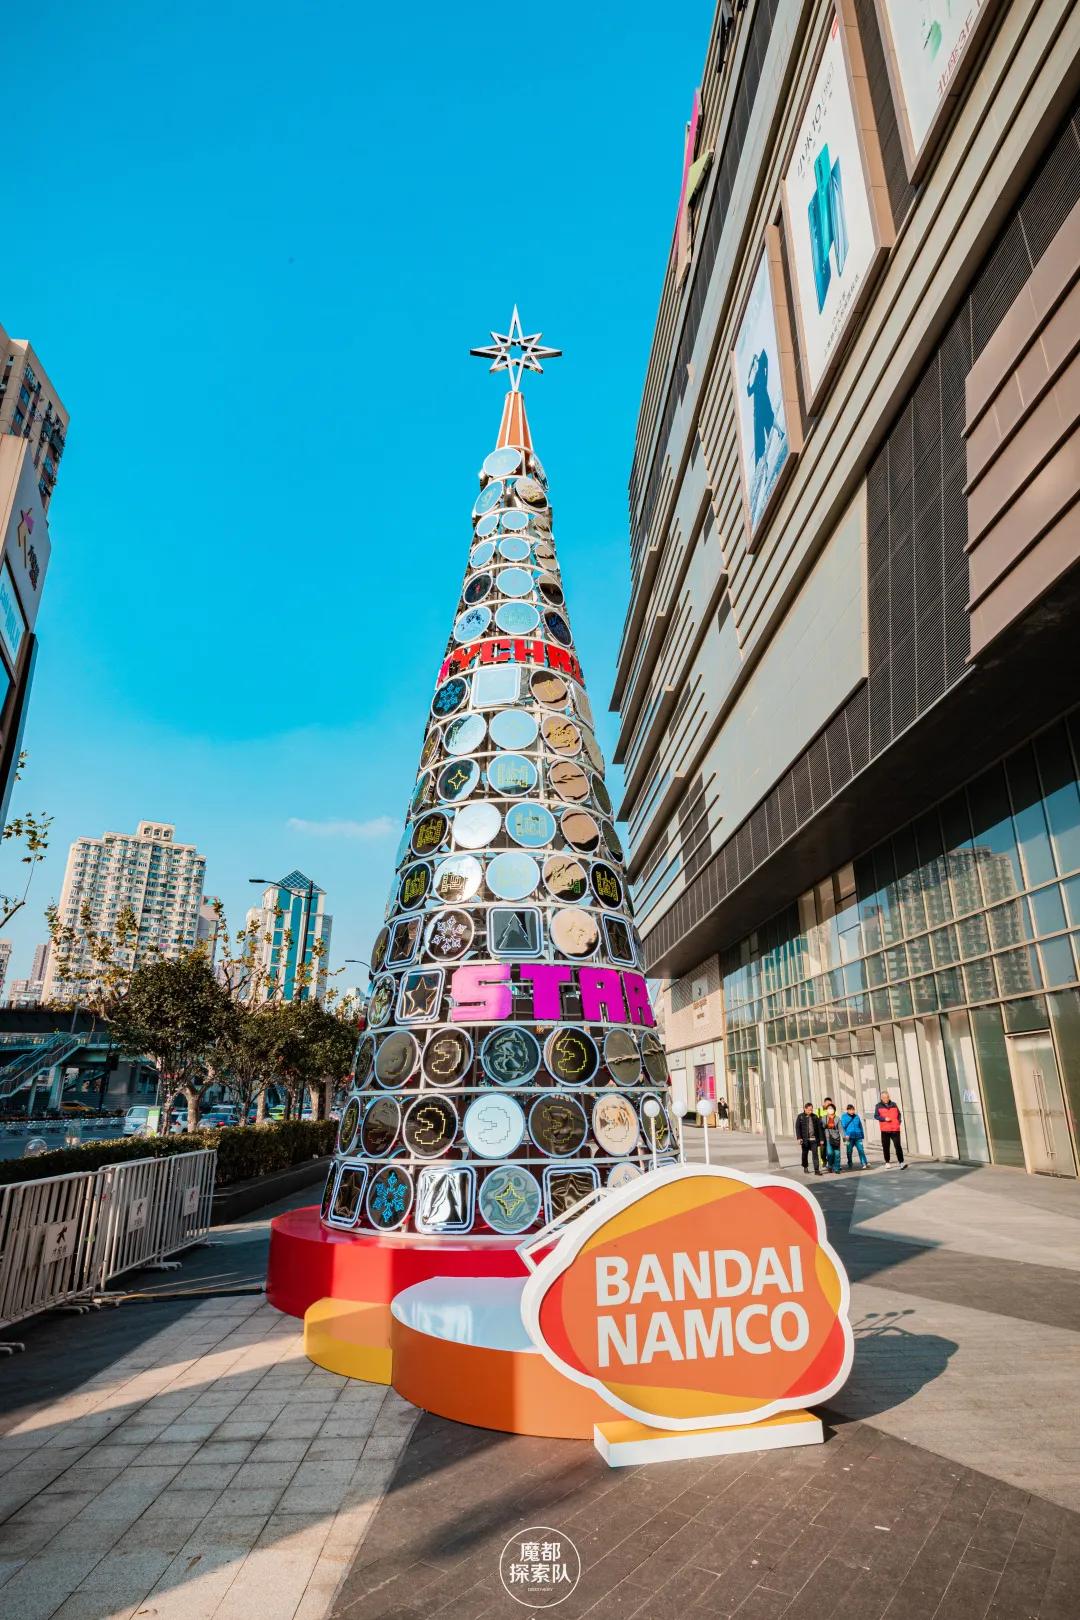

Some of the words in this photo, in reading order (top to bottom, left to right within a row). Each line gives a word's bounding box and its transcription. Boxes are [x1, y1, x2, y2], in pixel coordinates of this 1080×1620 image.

[451, 963, 657, 1028] STAR
[595, 1246, 804, 1306] BANDAI
[597, 1301, 810, 1367] NAMCO
